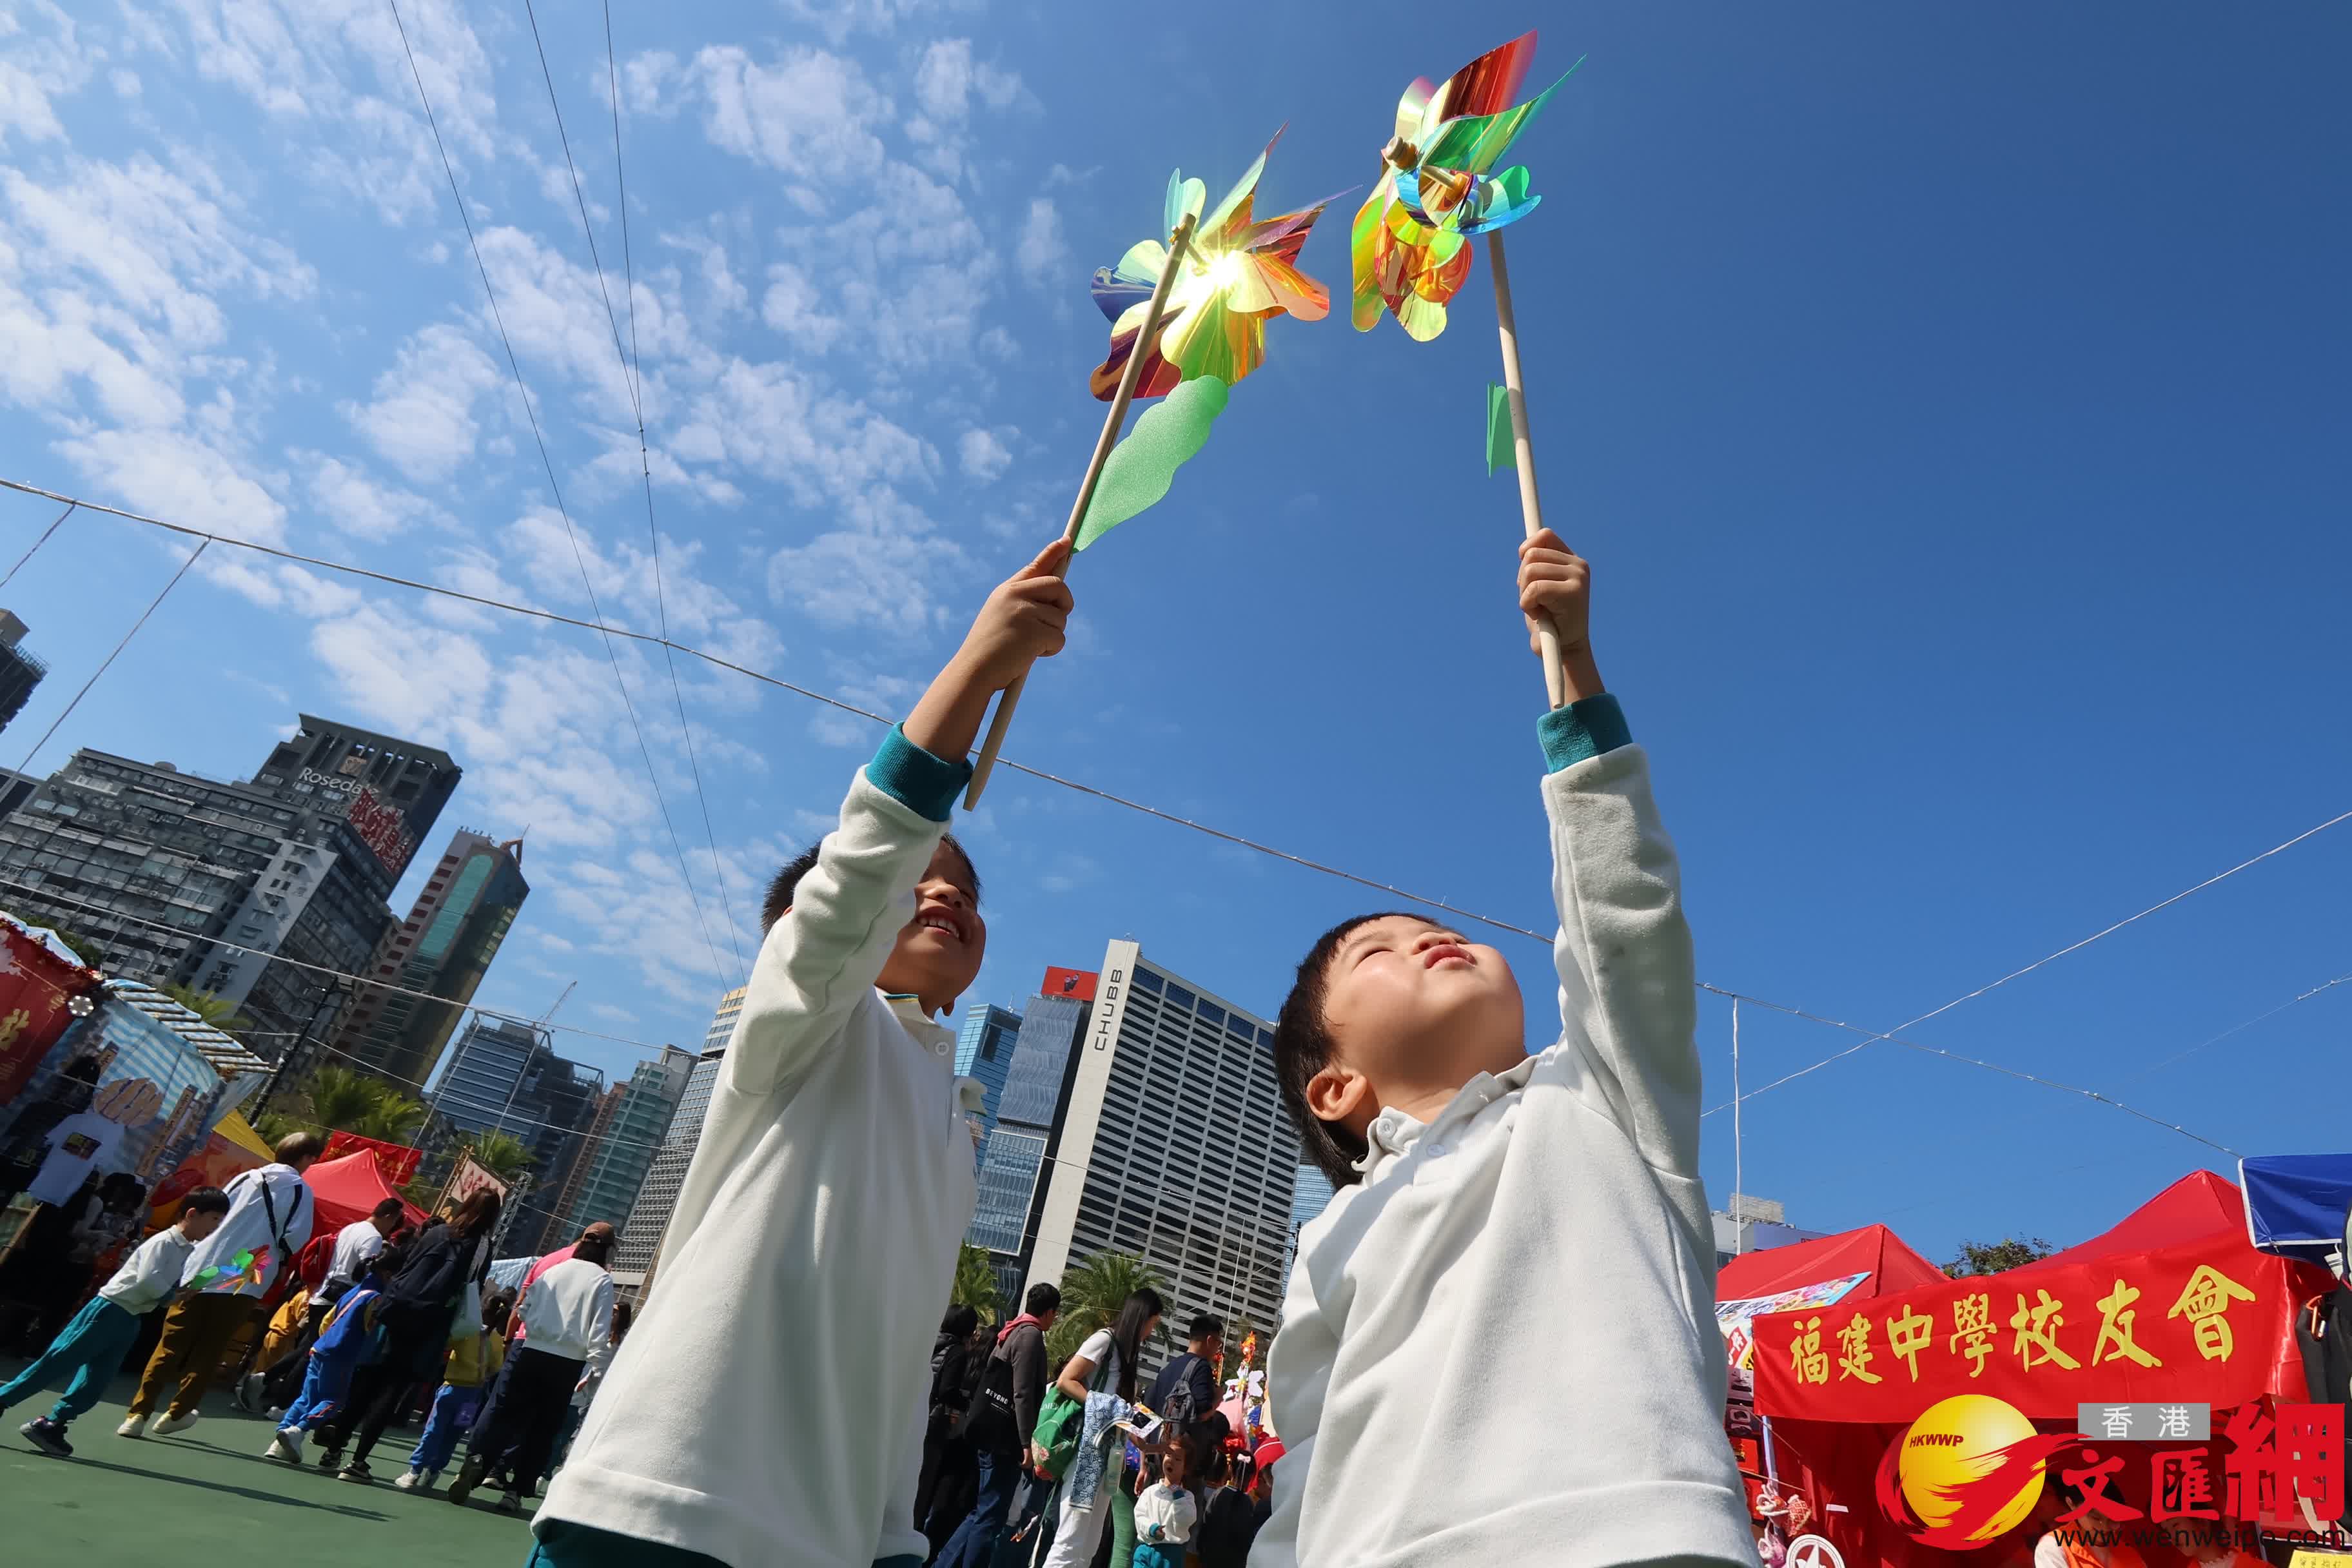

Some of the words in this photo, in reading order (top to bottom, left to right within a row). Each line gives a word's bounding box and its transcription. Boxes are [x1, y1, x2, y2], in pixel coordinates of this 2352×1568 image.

[1094, 969, 1122, 1051] CHUBB
[1789, 1264, 2256, 1385] 福建中學校友會
[985, 1388, 1008, 1405] BEYOND
